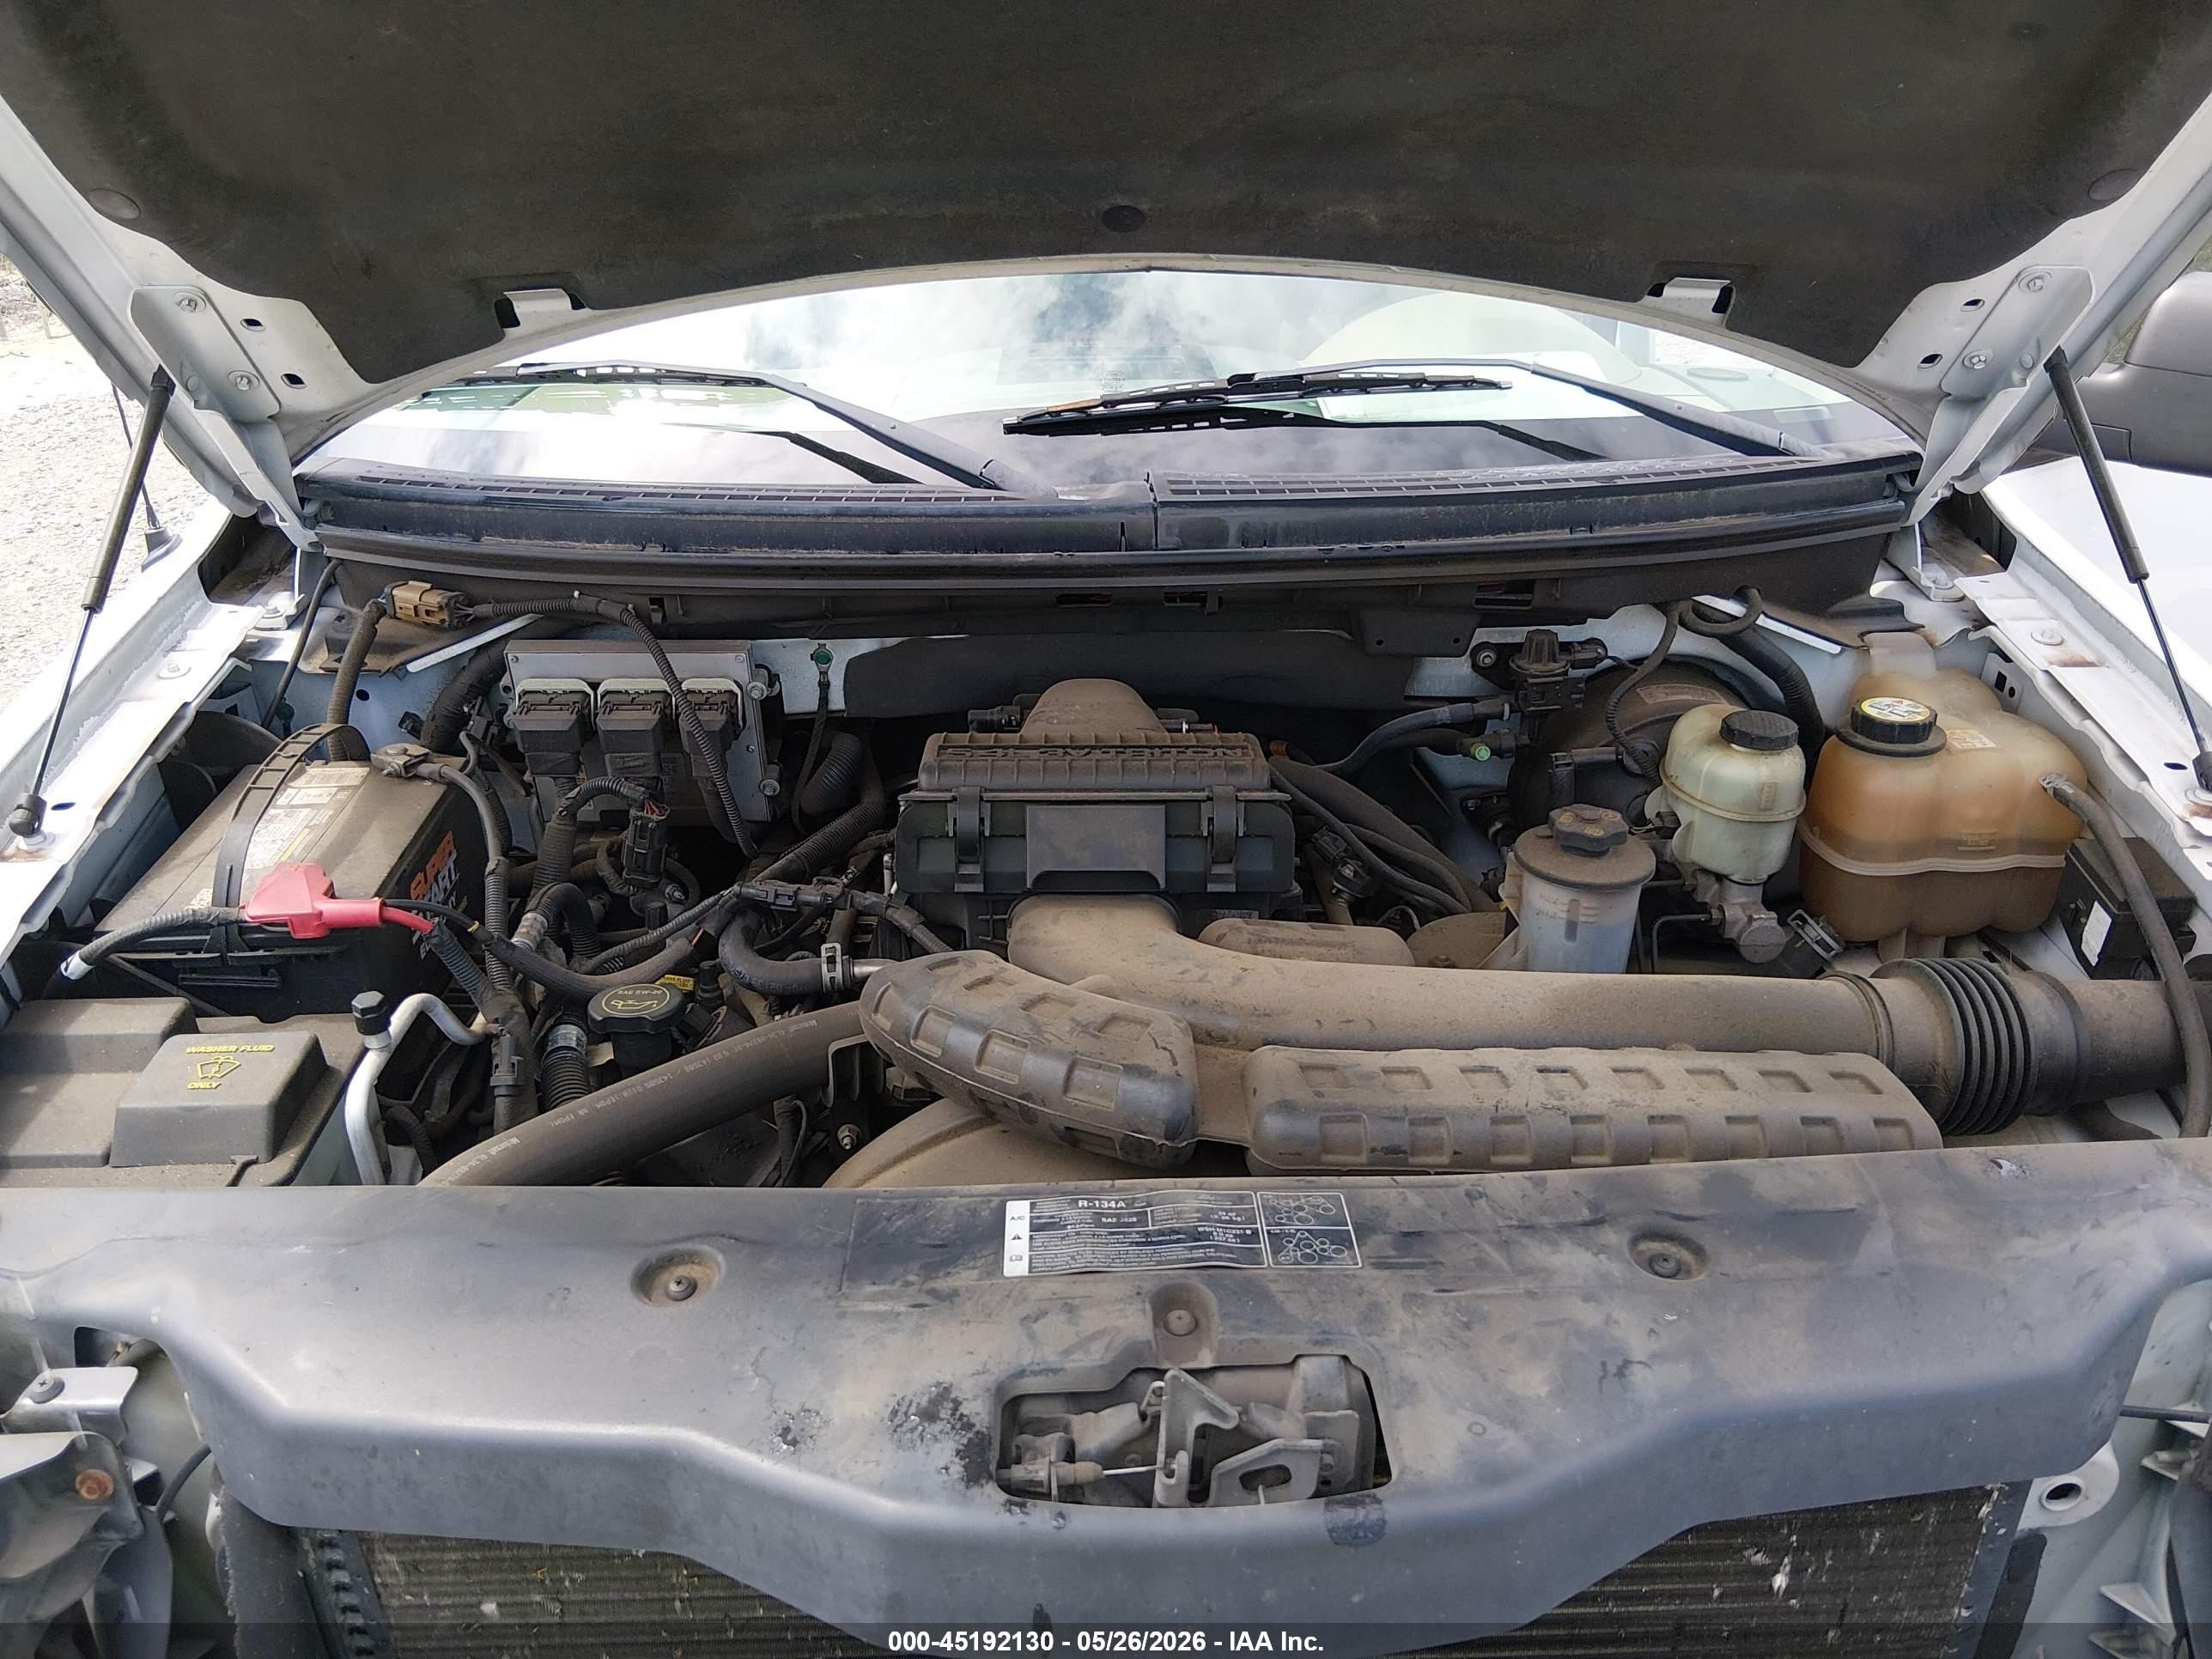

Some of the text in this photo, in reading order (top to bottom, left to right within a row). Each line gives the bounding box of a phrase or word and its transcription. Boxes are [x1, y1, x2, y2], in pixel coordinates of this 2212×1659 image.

[1100, 747, 1244, 758] TRITON
[185, 1044, 275, 1054] WASHER FLUID
[186, 1081, 222, 1091] ONLY
[1078, 1199, 1127, 1209] R-134A
